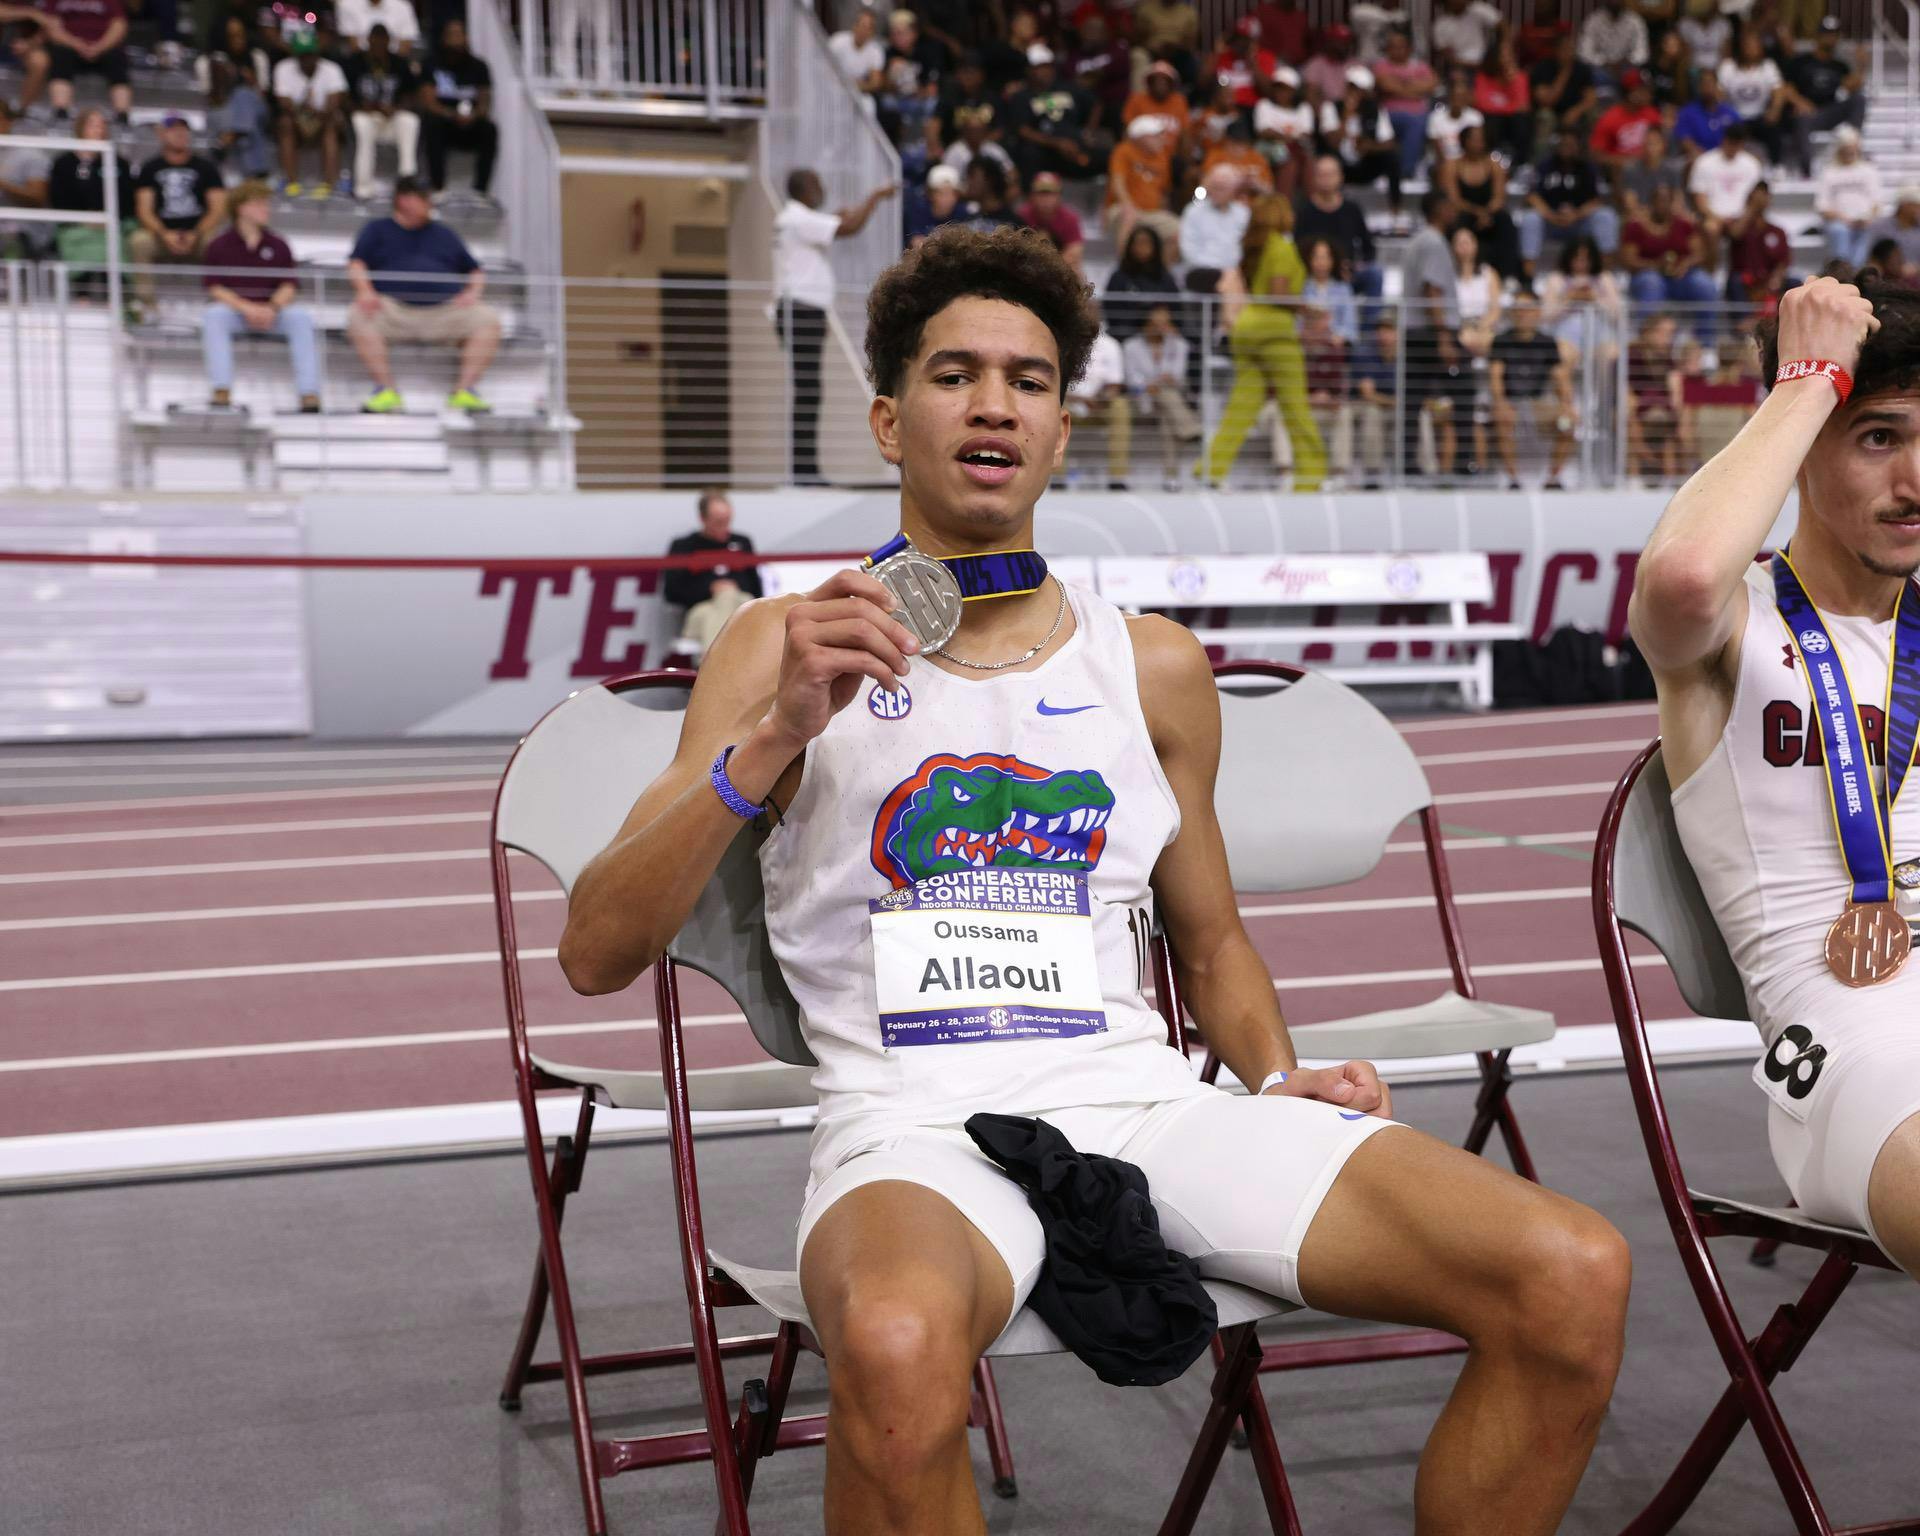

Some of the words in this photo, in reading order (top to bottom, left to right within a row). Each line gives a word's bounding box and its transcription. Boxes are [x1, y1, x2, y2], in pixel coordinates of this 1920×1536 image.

[1801, 631, 1829, 653] SEC
[870, 681, 910, 718] SEC
[1818, 662, 1841, 710] SCHOLARS.
[1832, 712, 1853, 769] CHAMPIONS.
[1843, 771, 1862, 817] LEADERS.
[915, 870, 1076, 890] SOUTHEASTERN
[918, 885, 1078, 907] CONFERENCE
[919, 901, 953, 909] INDOOR
[954, 901, 981, 909] TRACK
[990, 903, 1013, 911] FIELD
[1015, 904, 1078, 914] CHAMPIONSHIPS
[934, 920, 1039, 943] Oussama
[918, 956, 1062, 993] Allaoui
[887, 1020, 927, 1031] February
[928, 1019, 940, 1027] 26
[947, 1018, 961, 1027] 28,
[963, 1015, 986, 1025] 2026
[989, 1008, 1009, 1028] SEC
[1012, 1013, 1061, 1024] Bryan-College
[1062, 1017, 1089, 1026] Station,
[1764, 1024, 1828, 1100] 8
